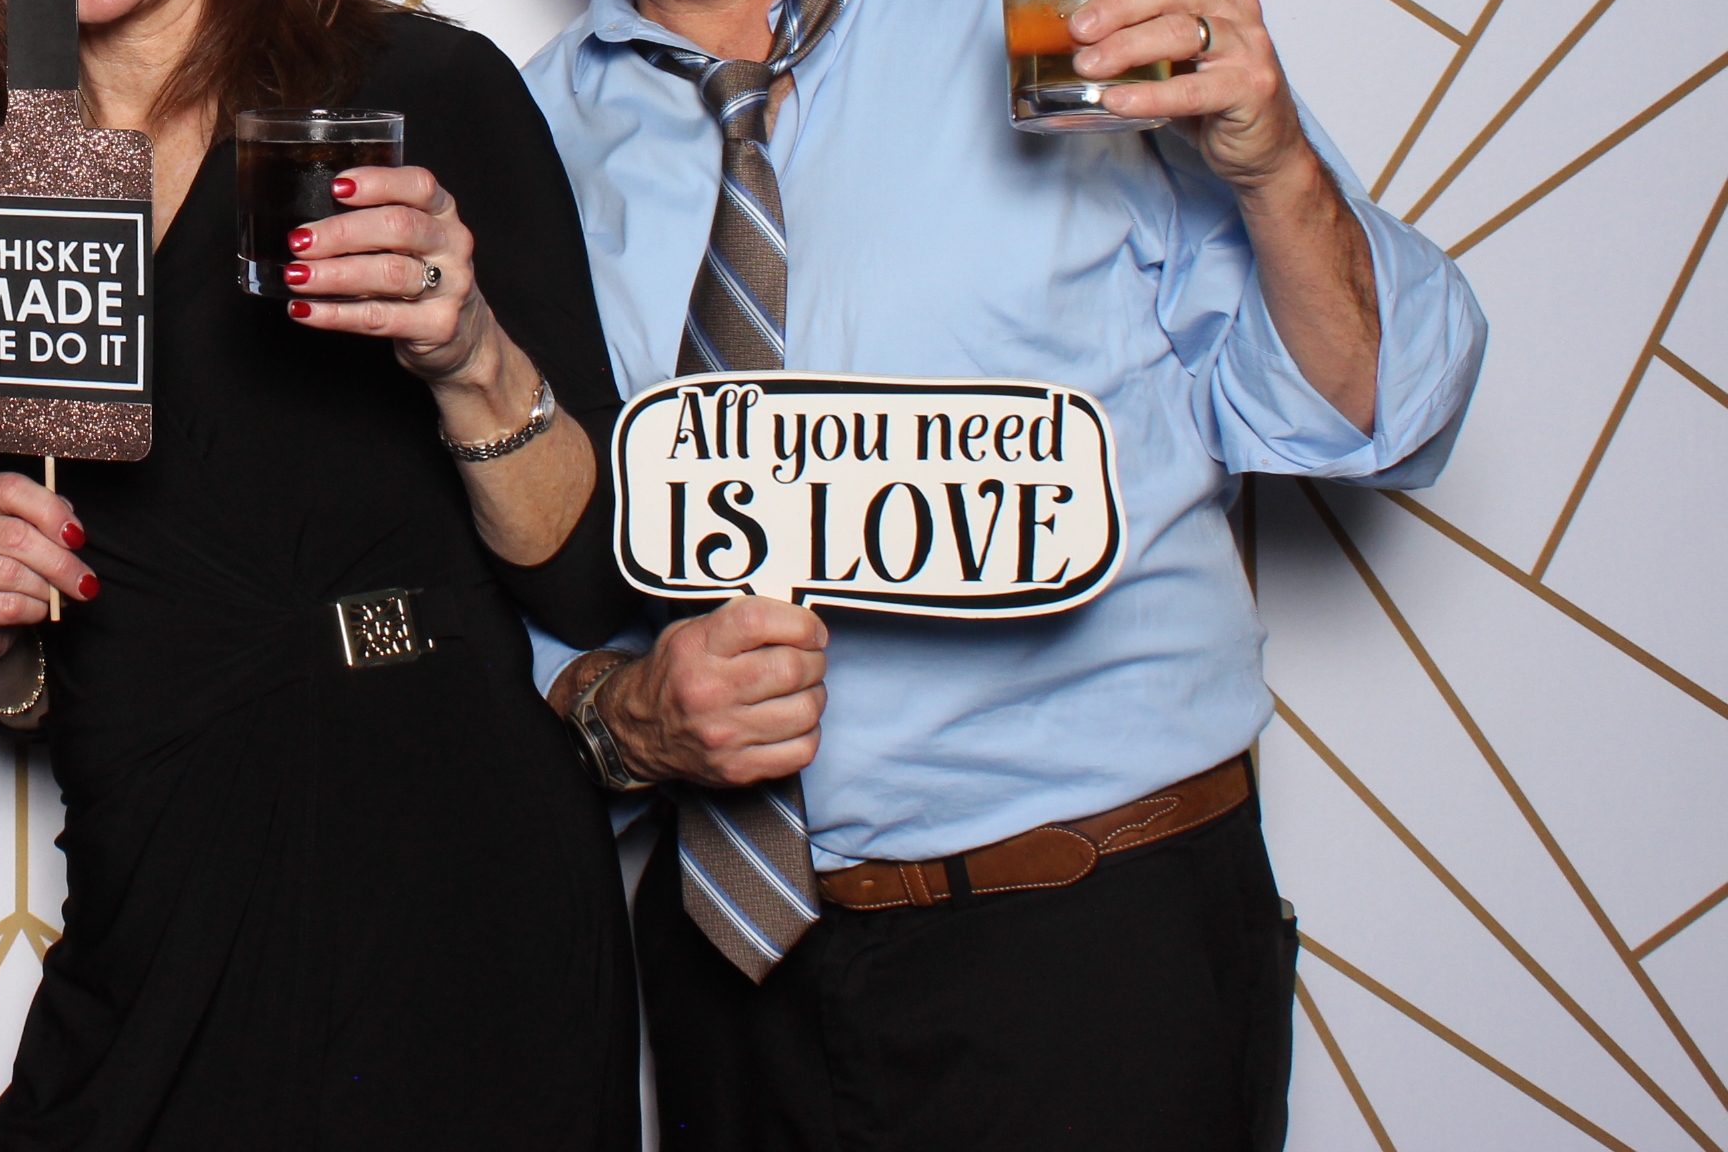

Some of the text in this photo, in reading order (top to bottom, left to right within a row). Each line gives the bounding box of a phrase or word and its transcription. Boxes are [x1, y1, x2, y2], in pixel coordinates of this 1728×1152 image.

[29, 331, 87, 364] DO
[101, 334, 126, 366] IT
[667, 388, 1064, 484] All you need
[667, 478, 1073, 583] IS LOVE
